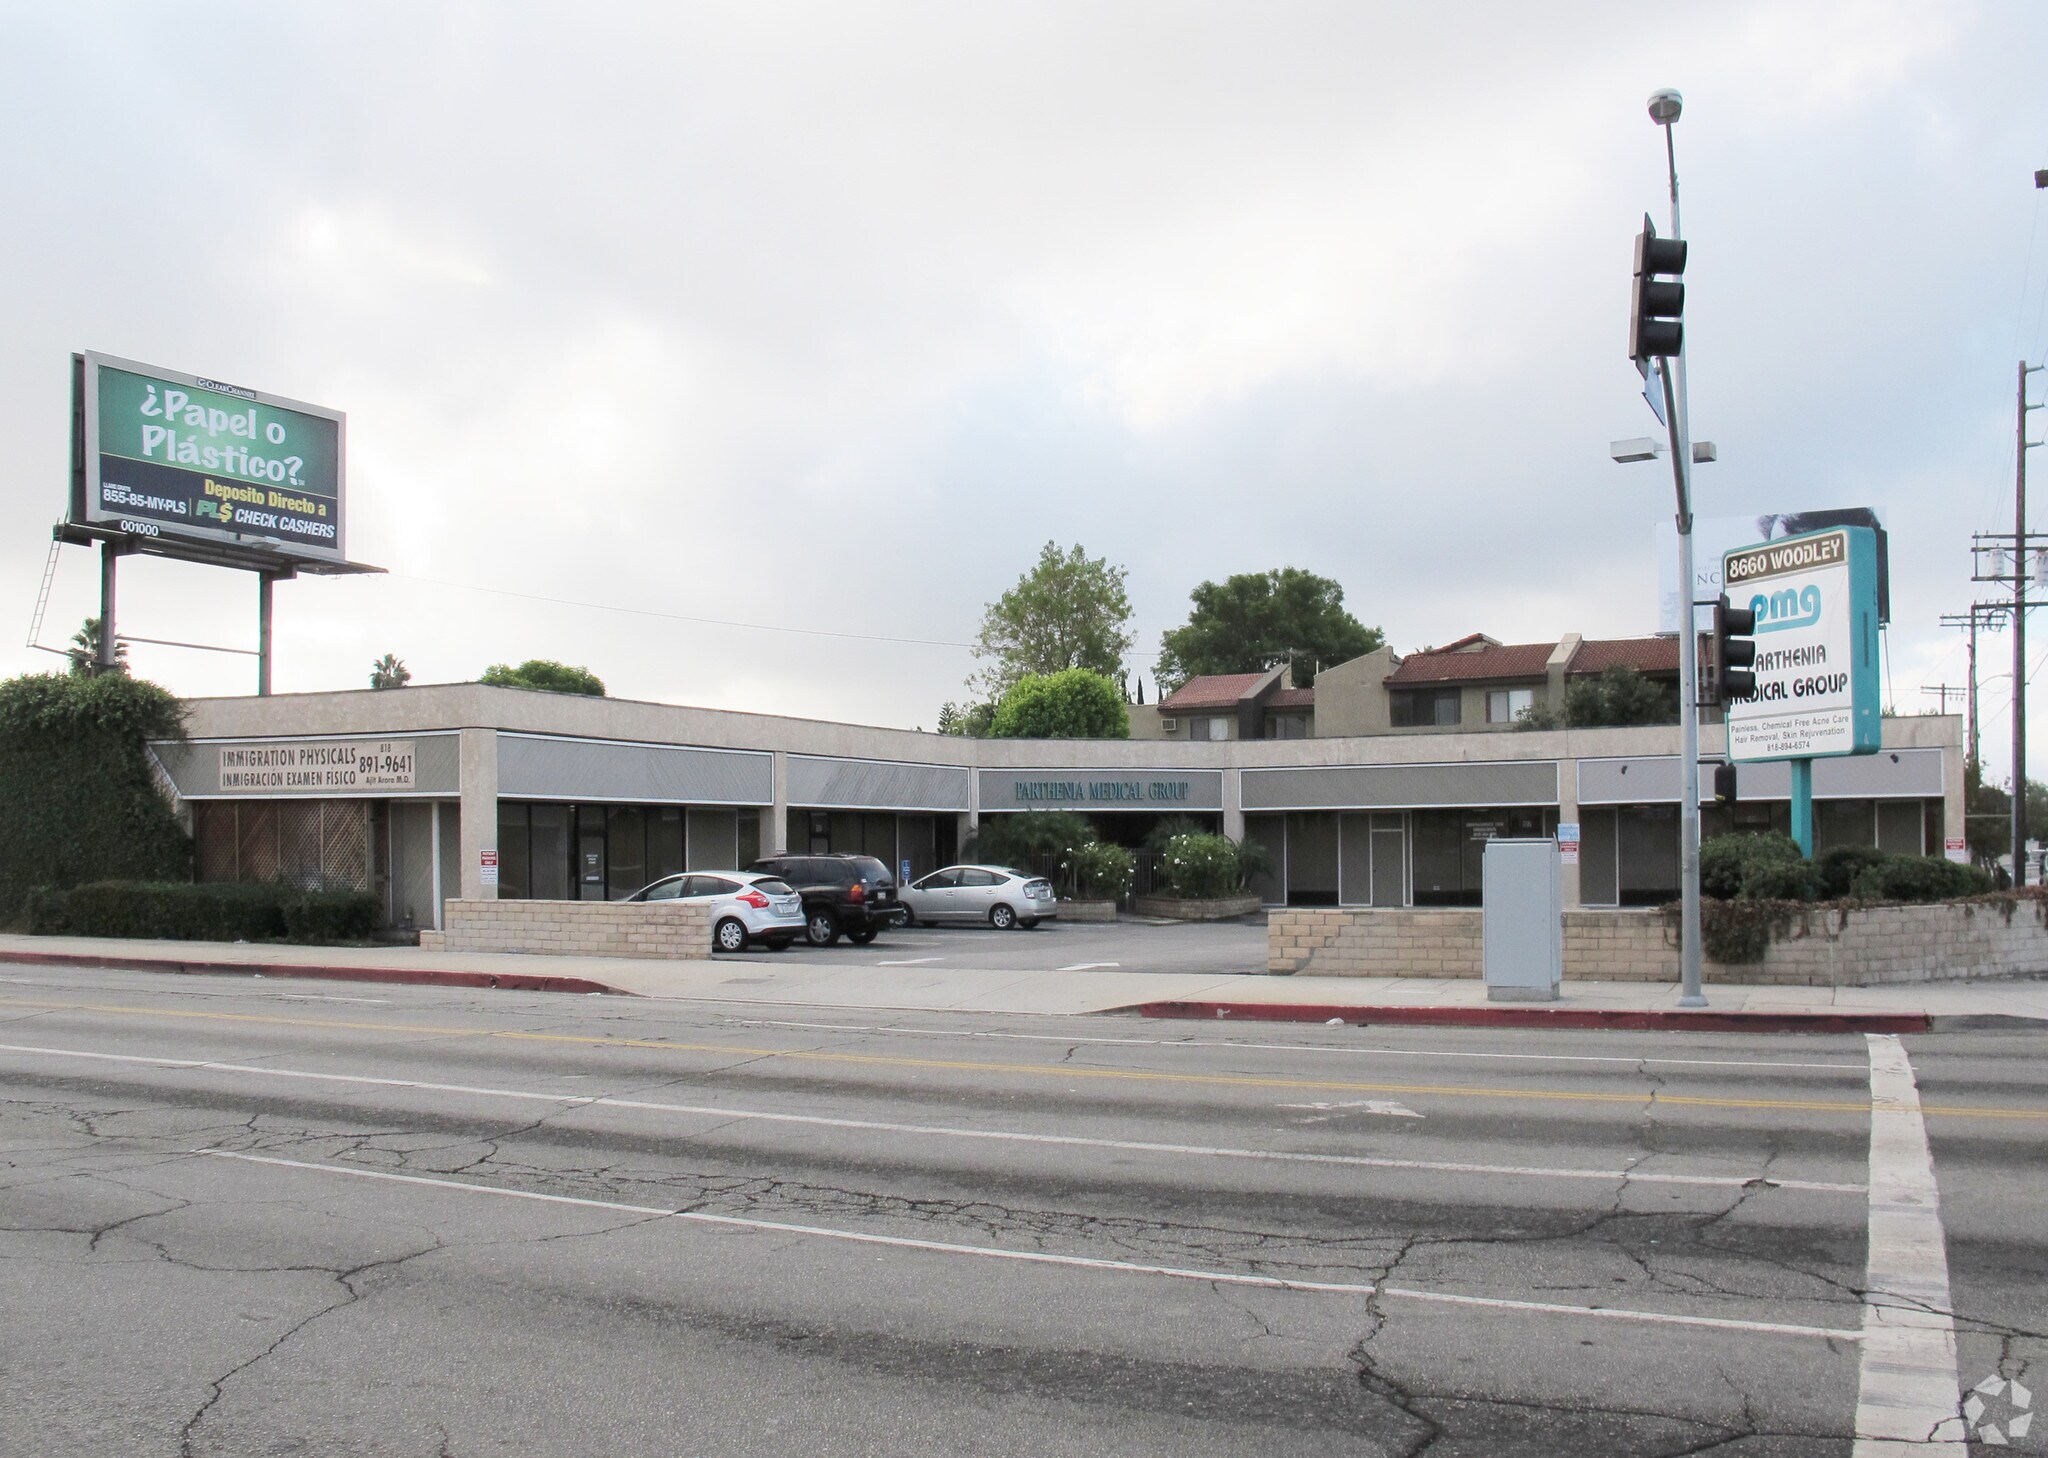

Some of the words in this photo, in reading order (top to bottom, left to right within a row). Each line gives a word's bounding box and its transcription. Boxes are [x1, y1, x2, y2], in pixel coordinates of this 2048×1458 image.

[140, 384, 257, 440] ¿Papel
[266, 422, 286, 445] o
[142, 424, 303, 486] Plástico?
[205, 479, 265, 505] Deposito
[268, 491, 315, 515] Directo
[318, 503, 327, 516] a
[121, 520, 159, 537] 001000
[235, 508, 277, 528] CHECK
[279, 516, 335, 538] CASHERS
[1729, 555, 1767, 578] 8660
[1770, 538, 1841, 569] WOODLEY
[1755, 644, 1827, 672] ARTHENIA
[1793, 672, 1848, 698] GROUP
[1761, 719, 1792, 731] Chemical
[1795, 718, 1810, 727] Free
[1812, 717, 1830, 725] Acne
[1832, 715, 1849, 723] Care
[1734, 735, 1748, 744] Hair
[1782, 730, 1797, 739] Skin
[1800, 727, 1845, 739] Rejuvenation
[380, 744, 391, 753] 818
[1767, 742, 1810, 752] 818-894-6574
[223, 749, 295, 767] IMMIGRATION
[300, 748, 356, 766] PHYSICALS
[359, 755, 412, 773] 891-9641
[223, 768, 282, 787] INMIGRACIÓN
[286, 771, 322, 786] EXAMEN
[326, 767, 356, 785] FÍSICO
[1015, 781, 1085, 800] PARTHENIA
[1089, 781, 1144, 800] MEDICAL
[1149, 781, 1190, 800] GROUP
